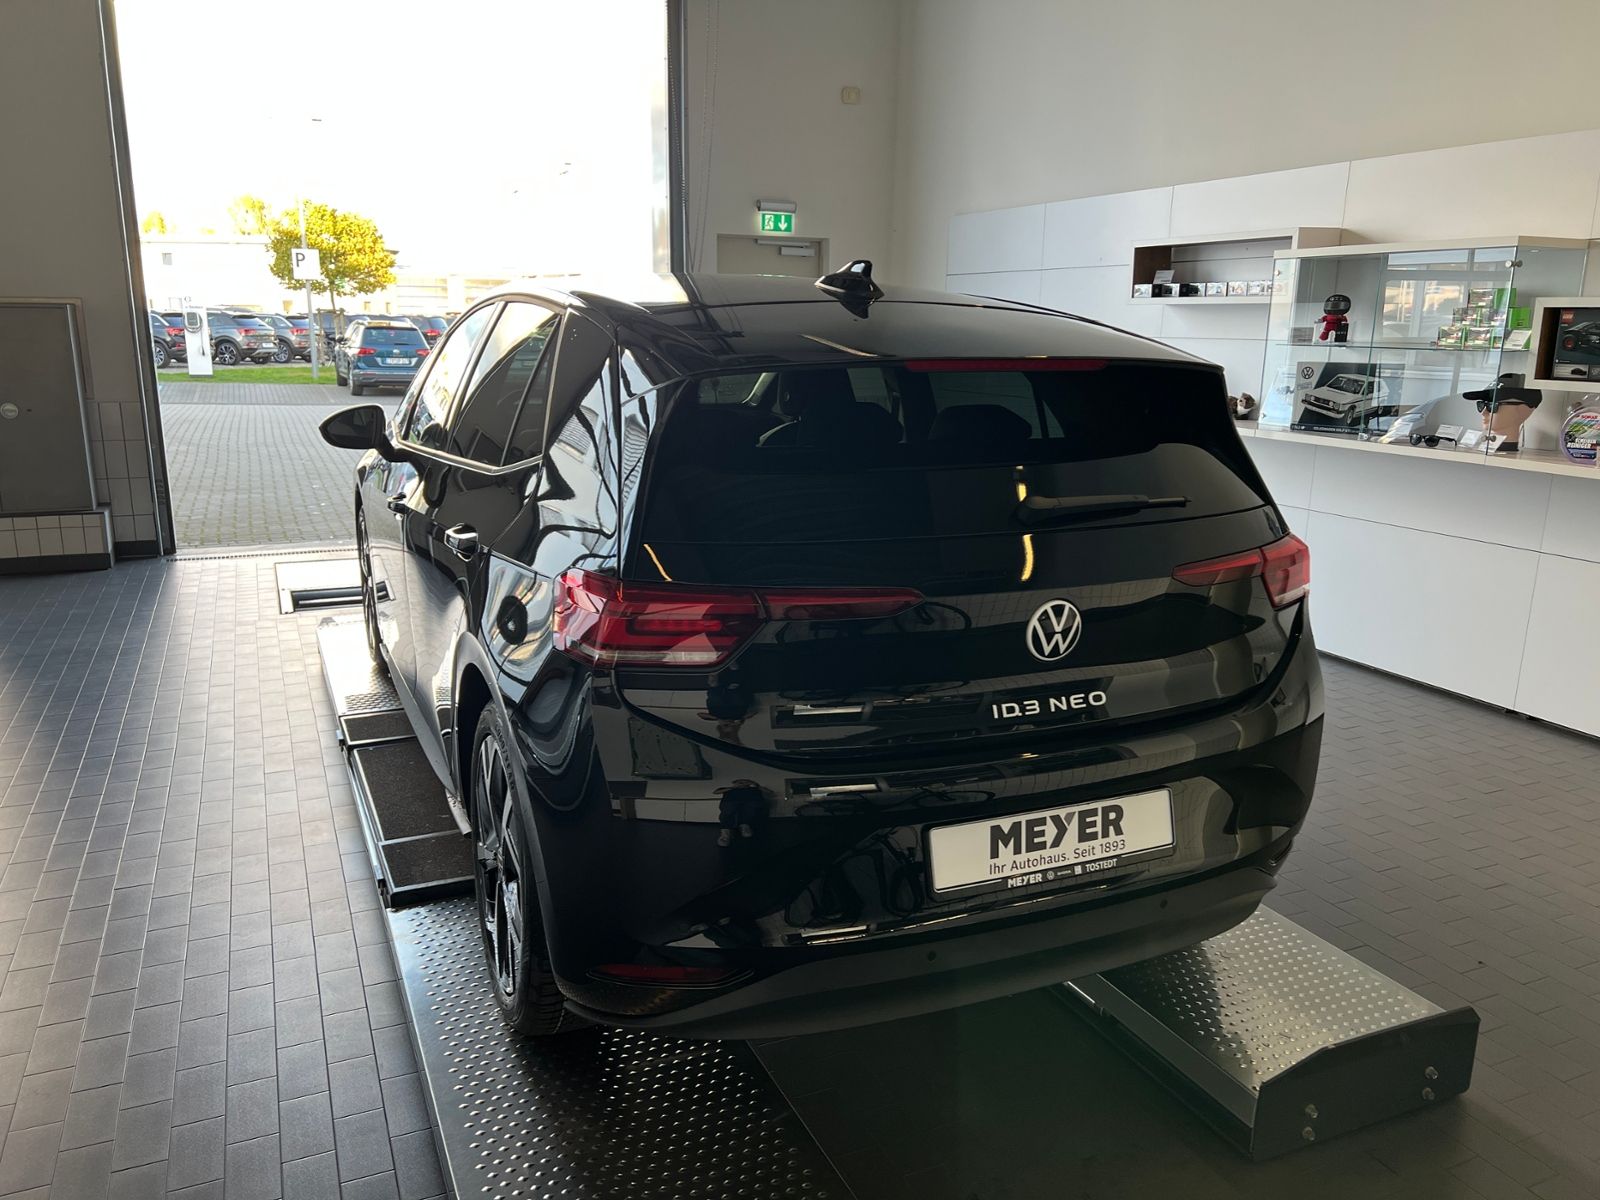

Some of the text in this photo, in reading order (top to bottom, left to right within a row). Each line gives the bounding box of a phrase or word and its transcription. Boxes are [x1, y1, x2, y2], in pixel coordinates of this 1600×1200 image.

[295, 252, 306, 267] P
[1049, 691, 1107, 713] NEO
[989, 804, 1125, 860] MEYER
[989, 839, 1126, 876] Ihr Autohaus. Seit 1893
[1007, 873, 1042, 889] MEYER
[1085, 858, 1118, 873] TOSTEDT
